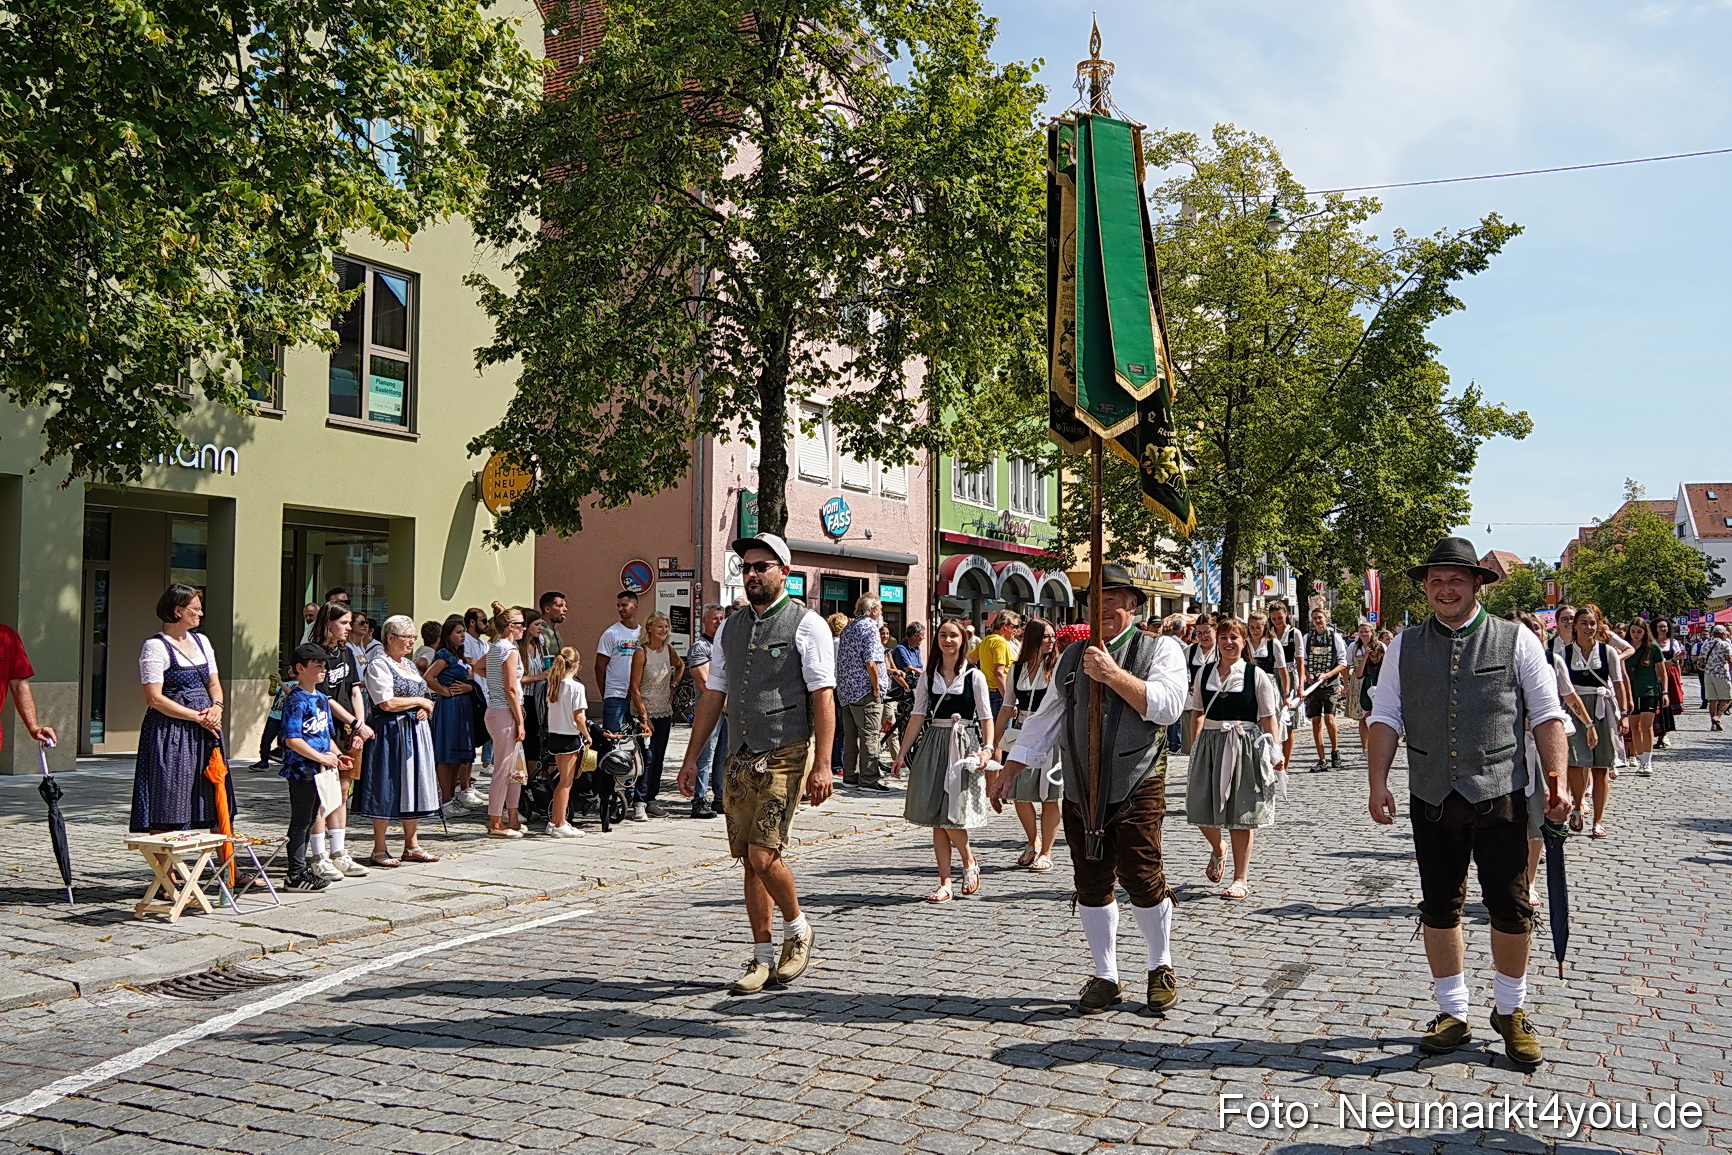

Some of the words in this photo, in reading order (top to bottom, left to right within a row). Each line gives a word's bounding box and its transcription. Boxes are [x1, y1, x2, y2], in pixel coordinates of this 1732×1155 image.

[376, 378, 396, 389] Planung
[375, 386, 402, 398] Bauleitung
[494, 467, 529, 478] HOTEL
[494, 478, 515, 489] NEU
[822, 501, 839, 516] vom
[827, 509, 851, 533] FASS
[660, 570, 693, 578] Bockwirtsgasse
[825, 585, 845, 596] Feinkost
